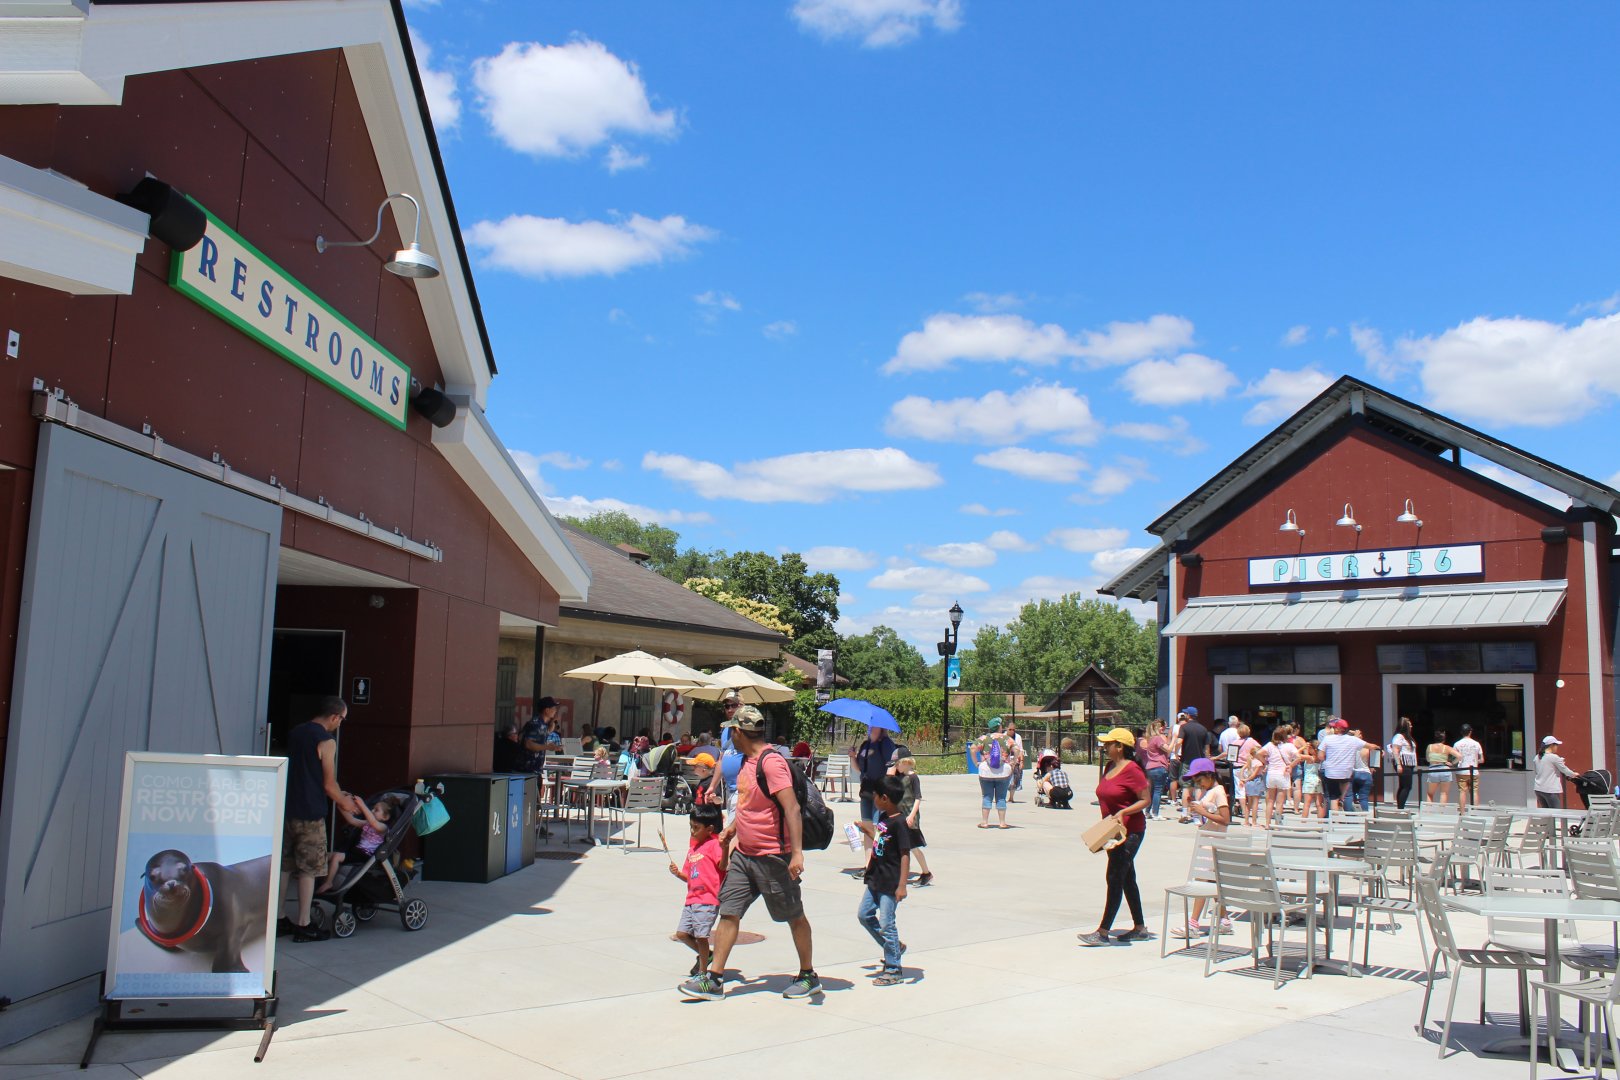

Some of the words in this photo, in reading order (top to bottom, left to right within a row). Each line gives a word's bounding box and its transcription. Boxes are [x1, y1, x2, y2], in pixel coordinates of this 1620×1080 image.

[198, 235, 402, 406] RESTROOMS
[1273, 555, 1359, 581] PIER
[1407, 549, 1452, 574] 56
[142, 774, 193, 789] COMO
[136, 788, 269, 808] RESTROOMS
[141, 806, 198, 823] NOW
[203, 808, 262, 825] OPEN
